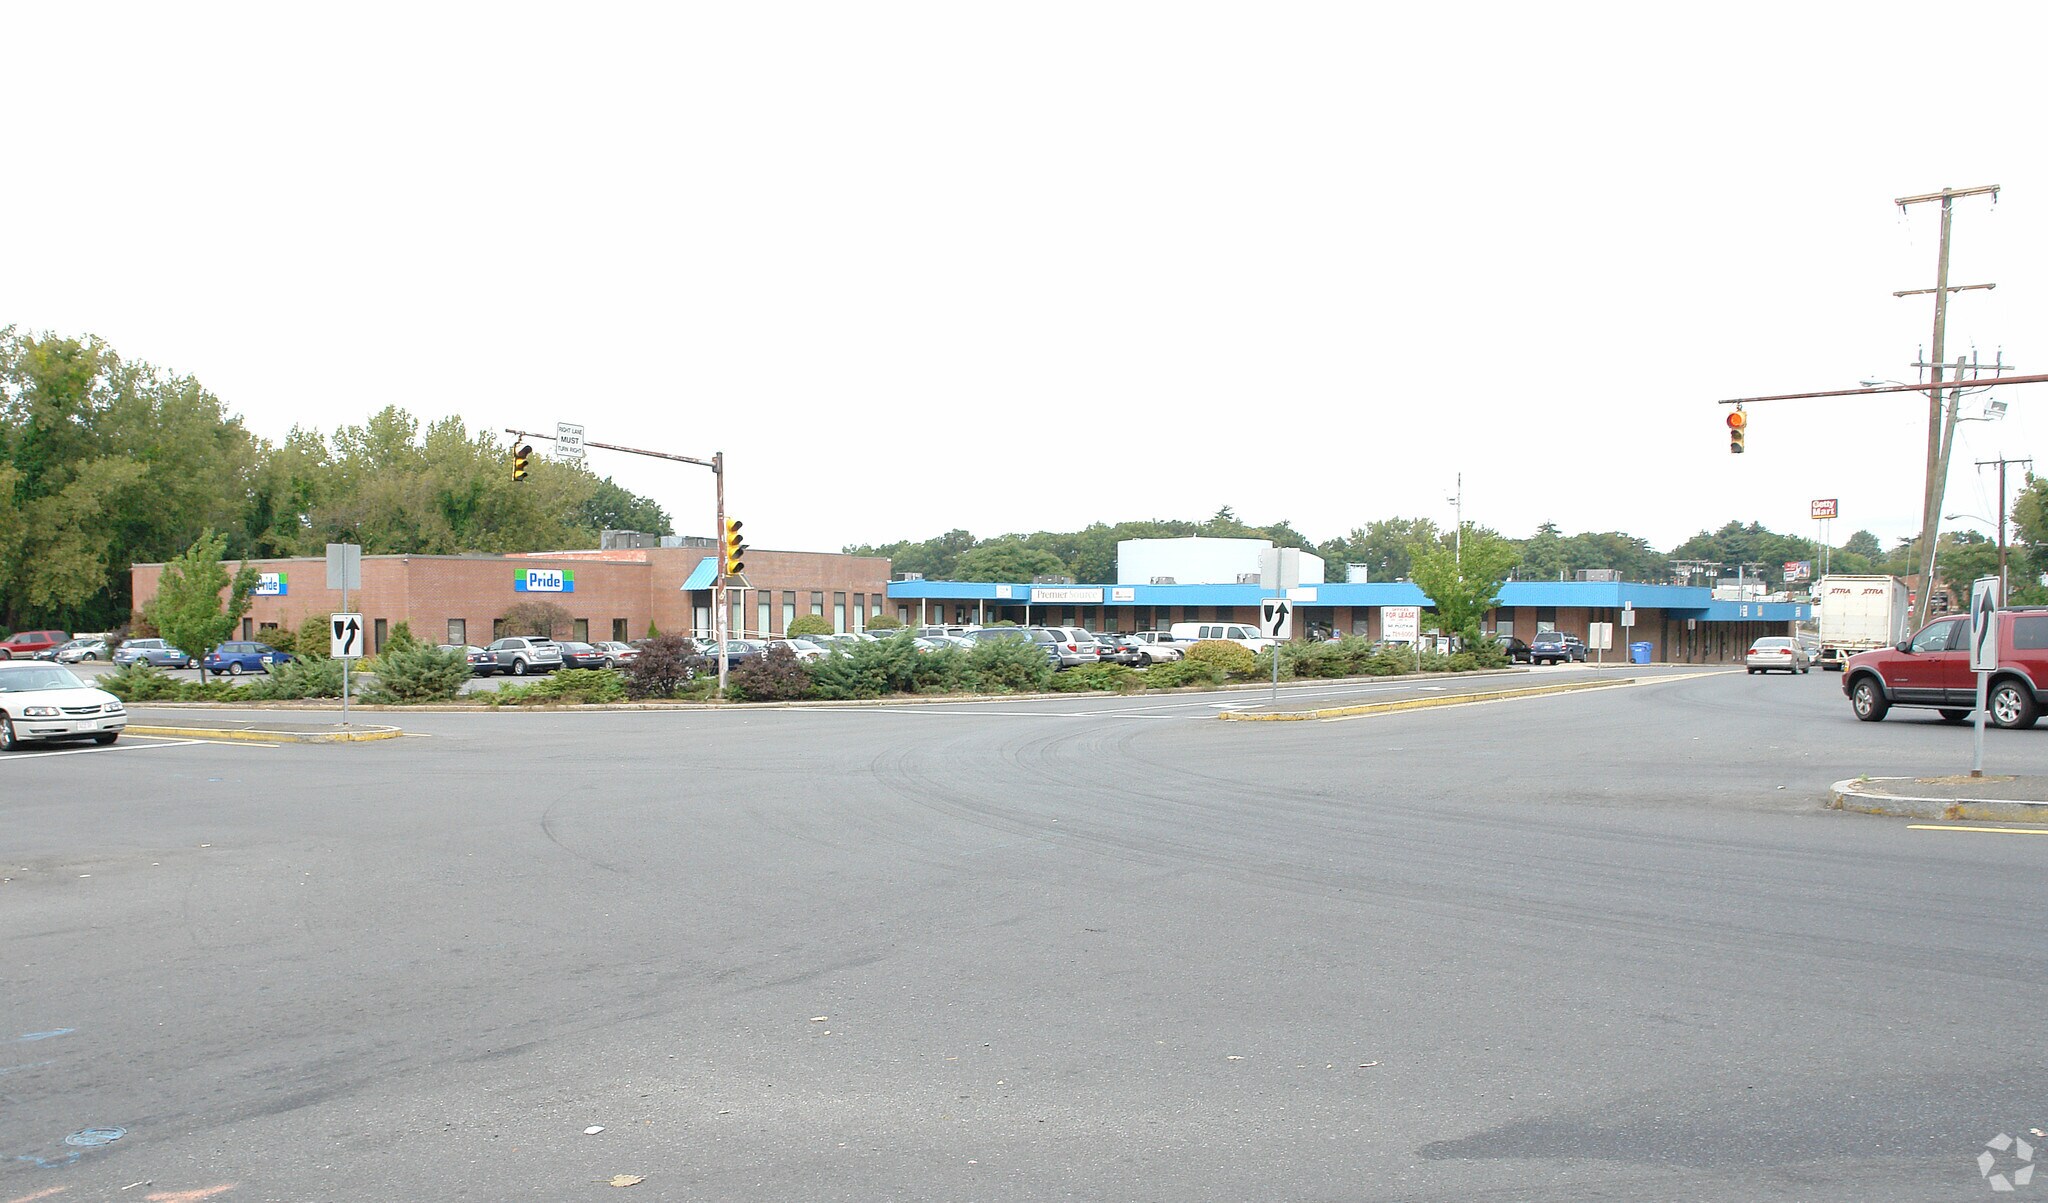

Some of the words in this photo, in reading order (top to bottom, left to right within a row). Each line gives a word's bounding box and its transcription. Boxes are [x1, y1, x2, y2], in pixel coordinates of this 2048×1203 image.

[561, 436, 579, 444] MUST
[530, 573, 560, 587] Pride
[1037, 590, 1067, 598] Premier
[1069, 590, 1097, 599] Source
